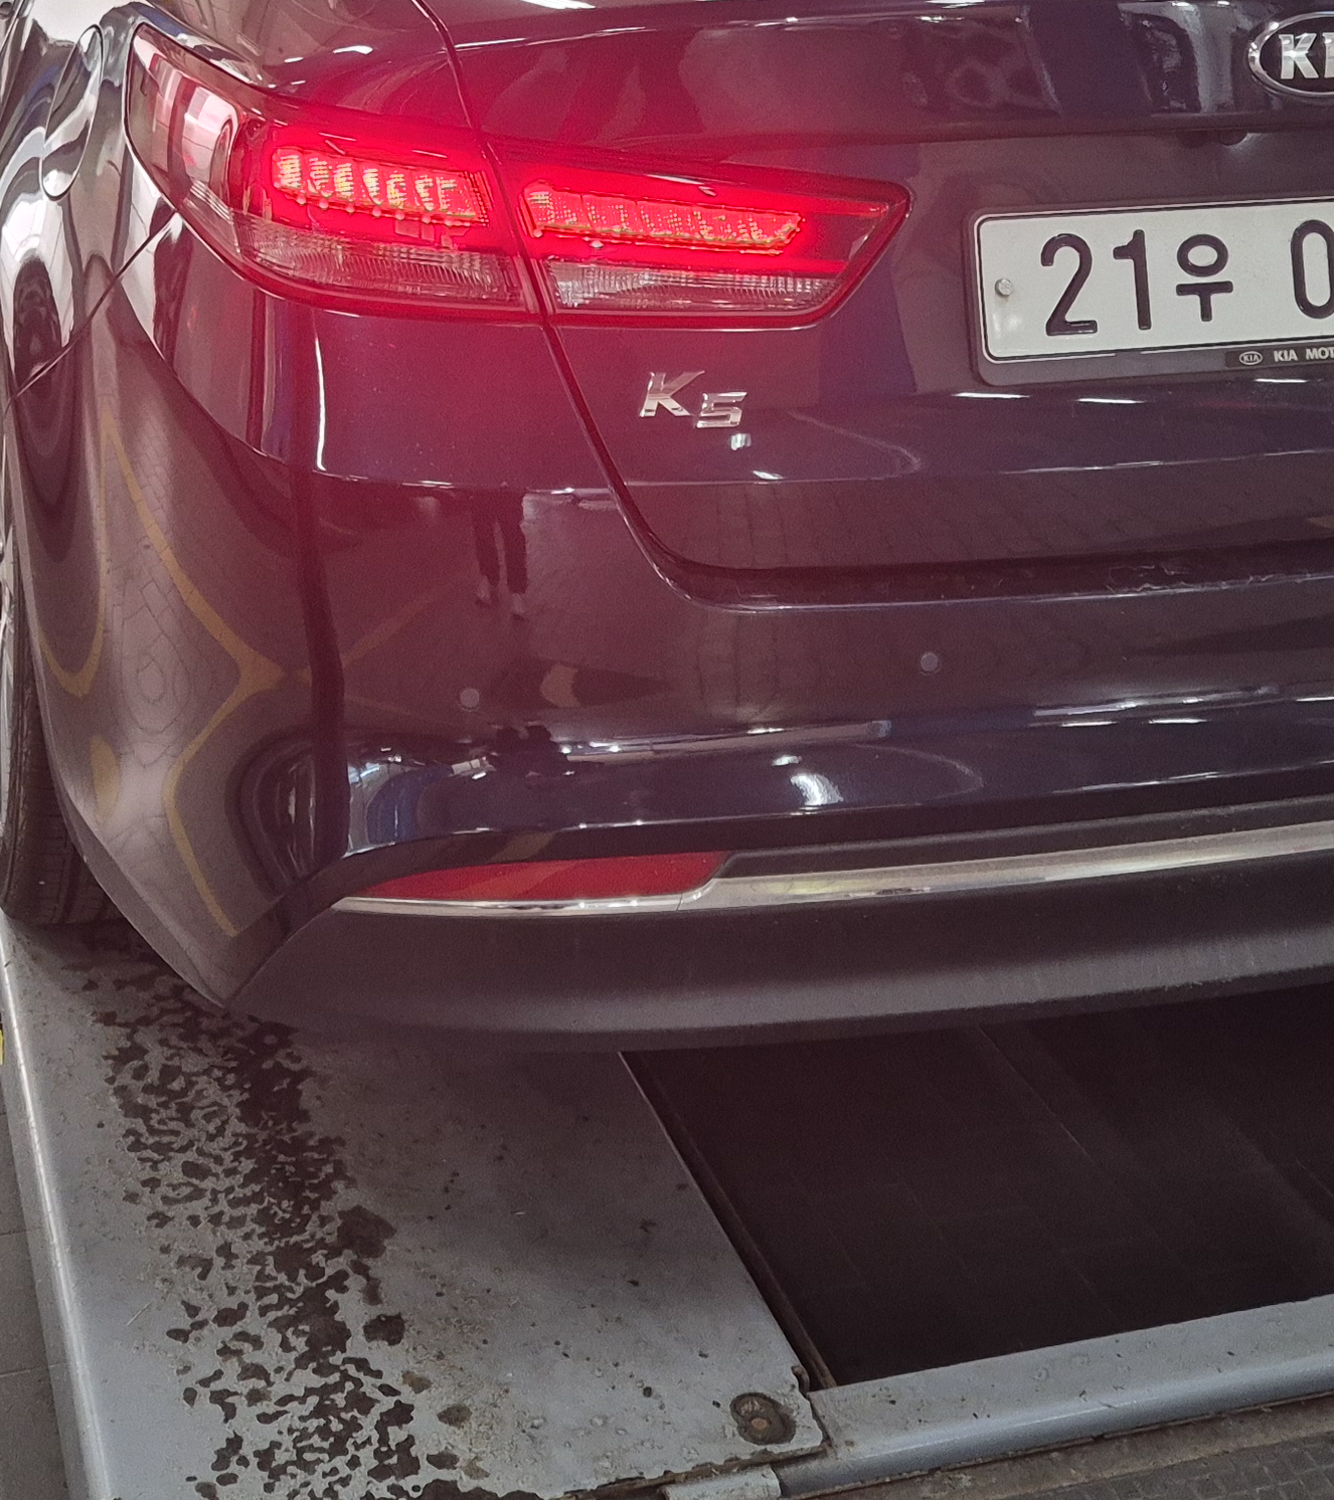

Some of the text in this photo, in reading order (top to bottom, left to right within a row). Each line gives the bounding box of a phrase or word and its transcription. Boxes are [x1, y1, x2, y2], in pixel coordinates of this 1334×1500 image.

[1039, 229, 1234, 337] 21우
[1242, 354, 1260, 363] KIA
[1273, 350, 1299, 362] KIA
[638, 370, 748, 428] K5
